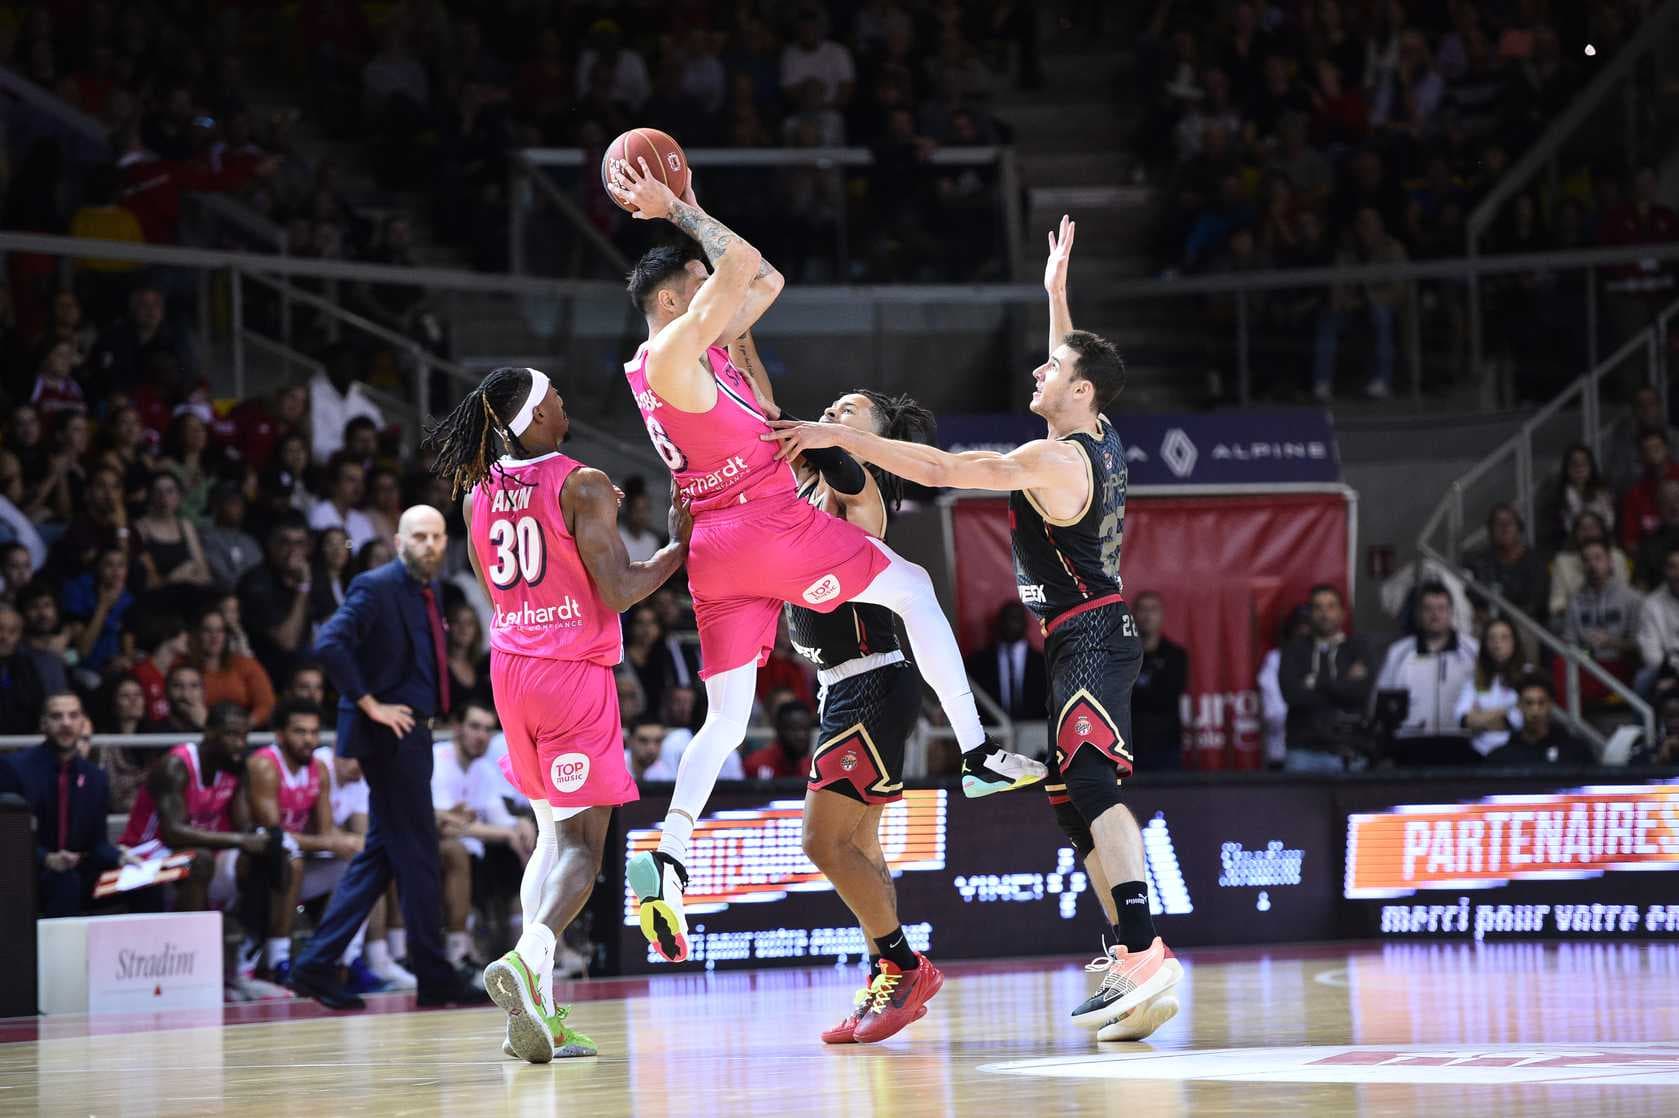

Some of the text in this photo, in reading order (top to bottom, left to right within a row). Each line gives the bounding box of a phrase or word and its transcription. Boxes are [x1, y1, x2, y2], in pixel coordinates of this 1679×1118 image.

[1211, 441, 1328, 460] ALPINE
[488, 515, 547, 591] 30
[807, 578, 833, 599] TOP
[555, 761, 584, 777] TOP
[556, 773, 583, 784] music
[1402, 800, 1679, 881] PARTENAIRES
[1125, 896, 1147, 906] PUMA
[1380, 896, 1470, 933] merci
[1473, 904, 1551, 942] pour
[1553, 902, 1641, 932] votre
[115, 942, 197, 981] Stradim
